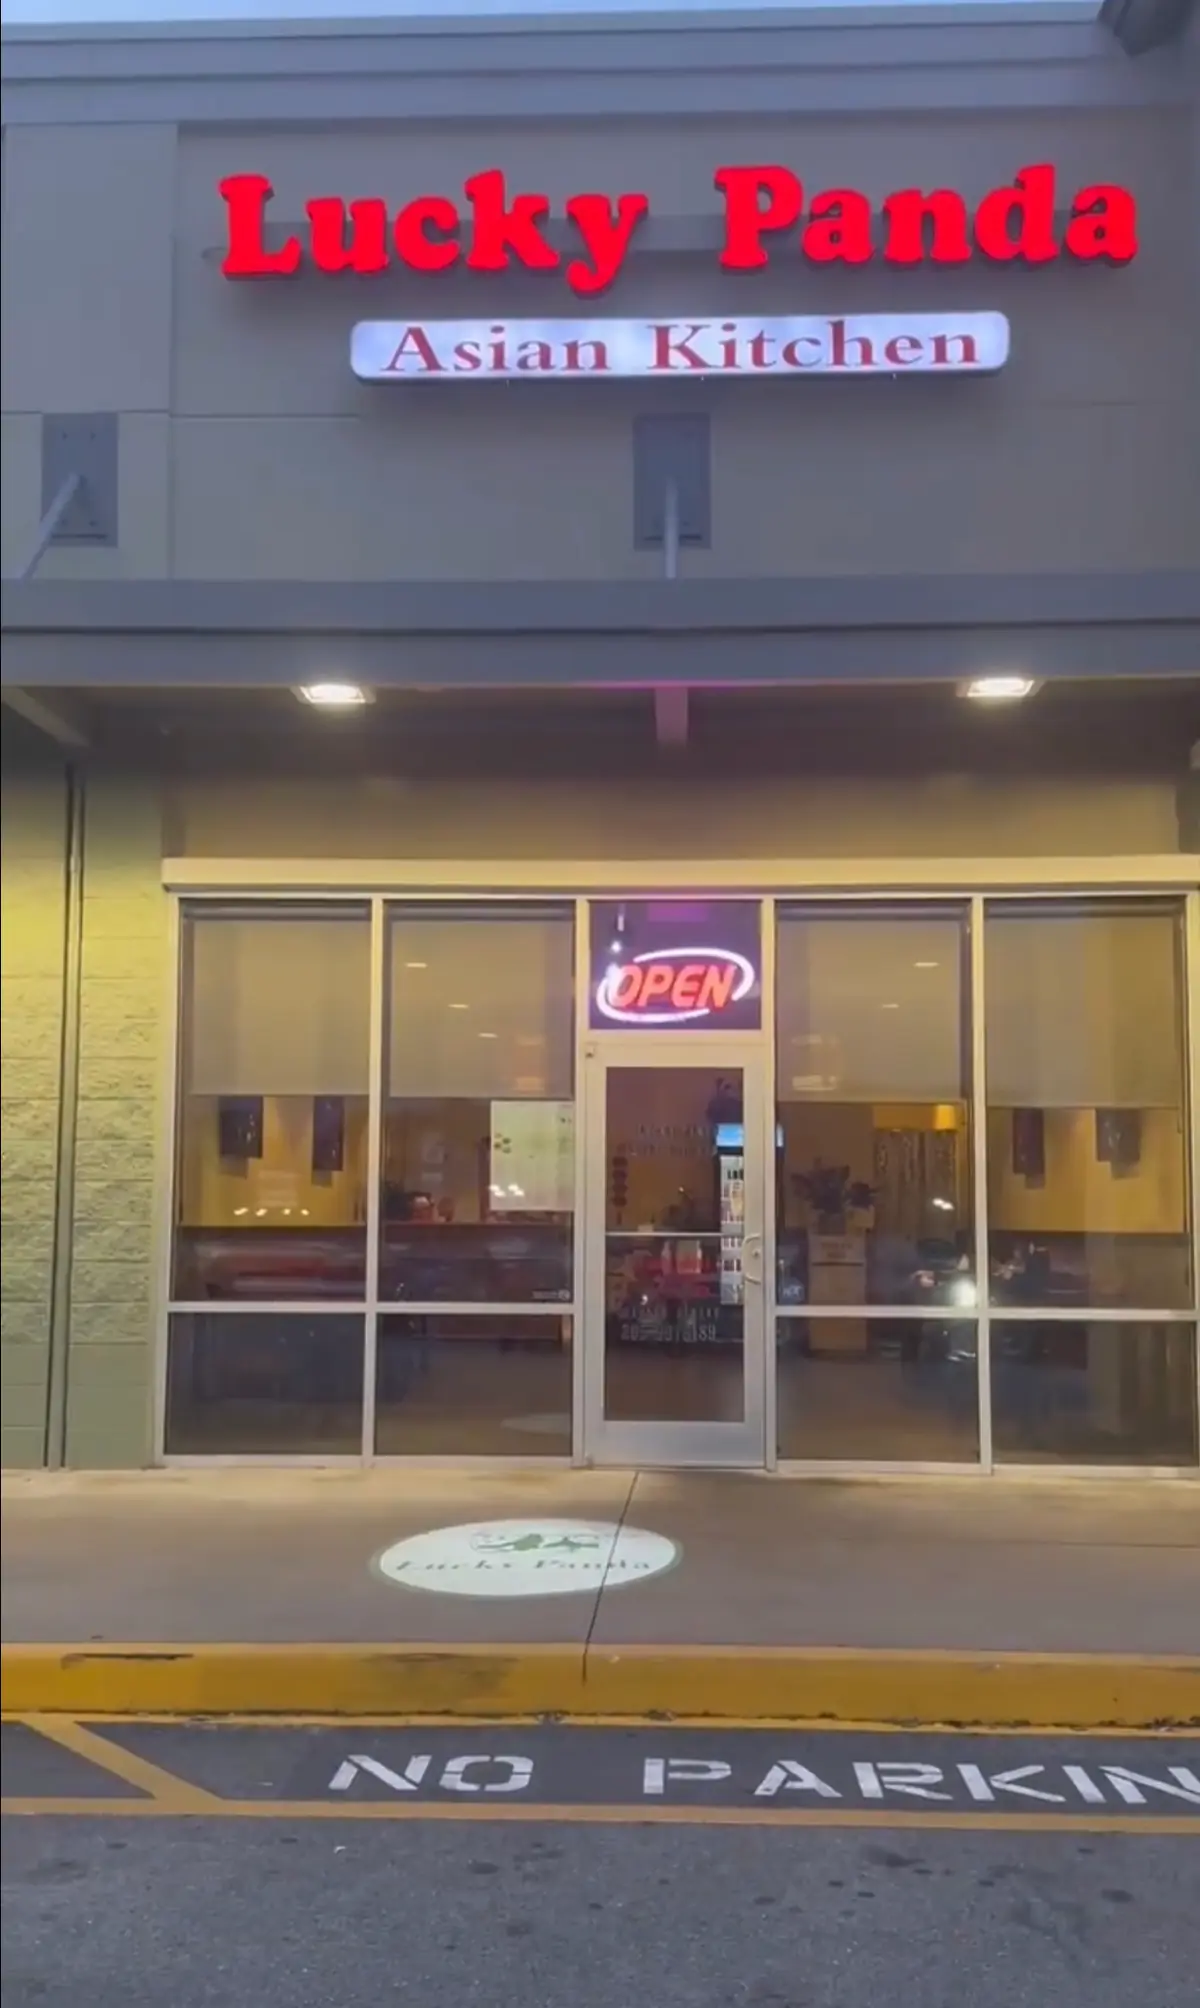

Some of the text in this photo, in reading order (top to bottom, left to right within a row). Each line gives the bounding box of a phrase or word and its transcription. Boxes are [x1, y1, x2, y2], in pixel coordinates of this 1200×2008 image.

[219, 164, 1138, 293] Lucky Panda
[384, 320, 982, 372] Asian Kitchen
[607, 964, 737, 1008] OPEN
[328, 1754, 1200, 1804] NO PARKIN
